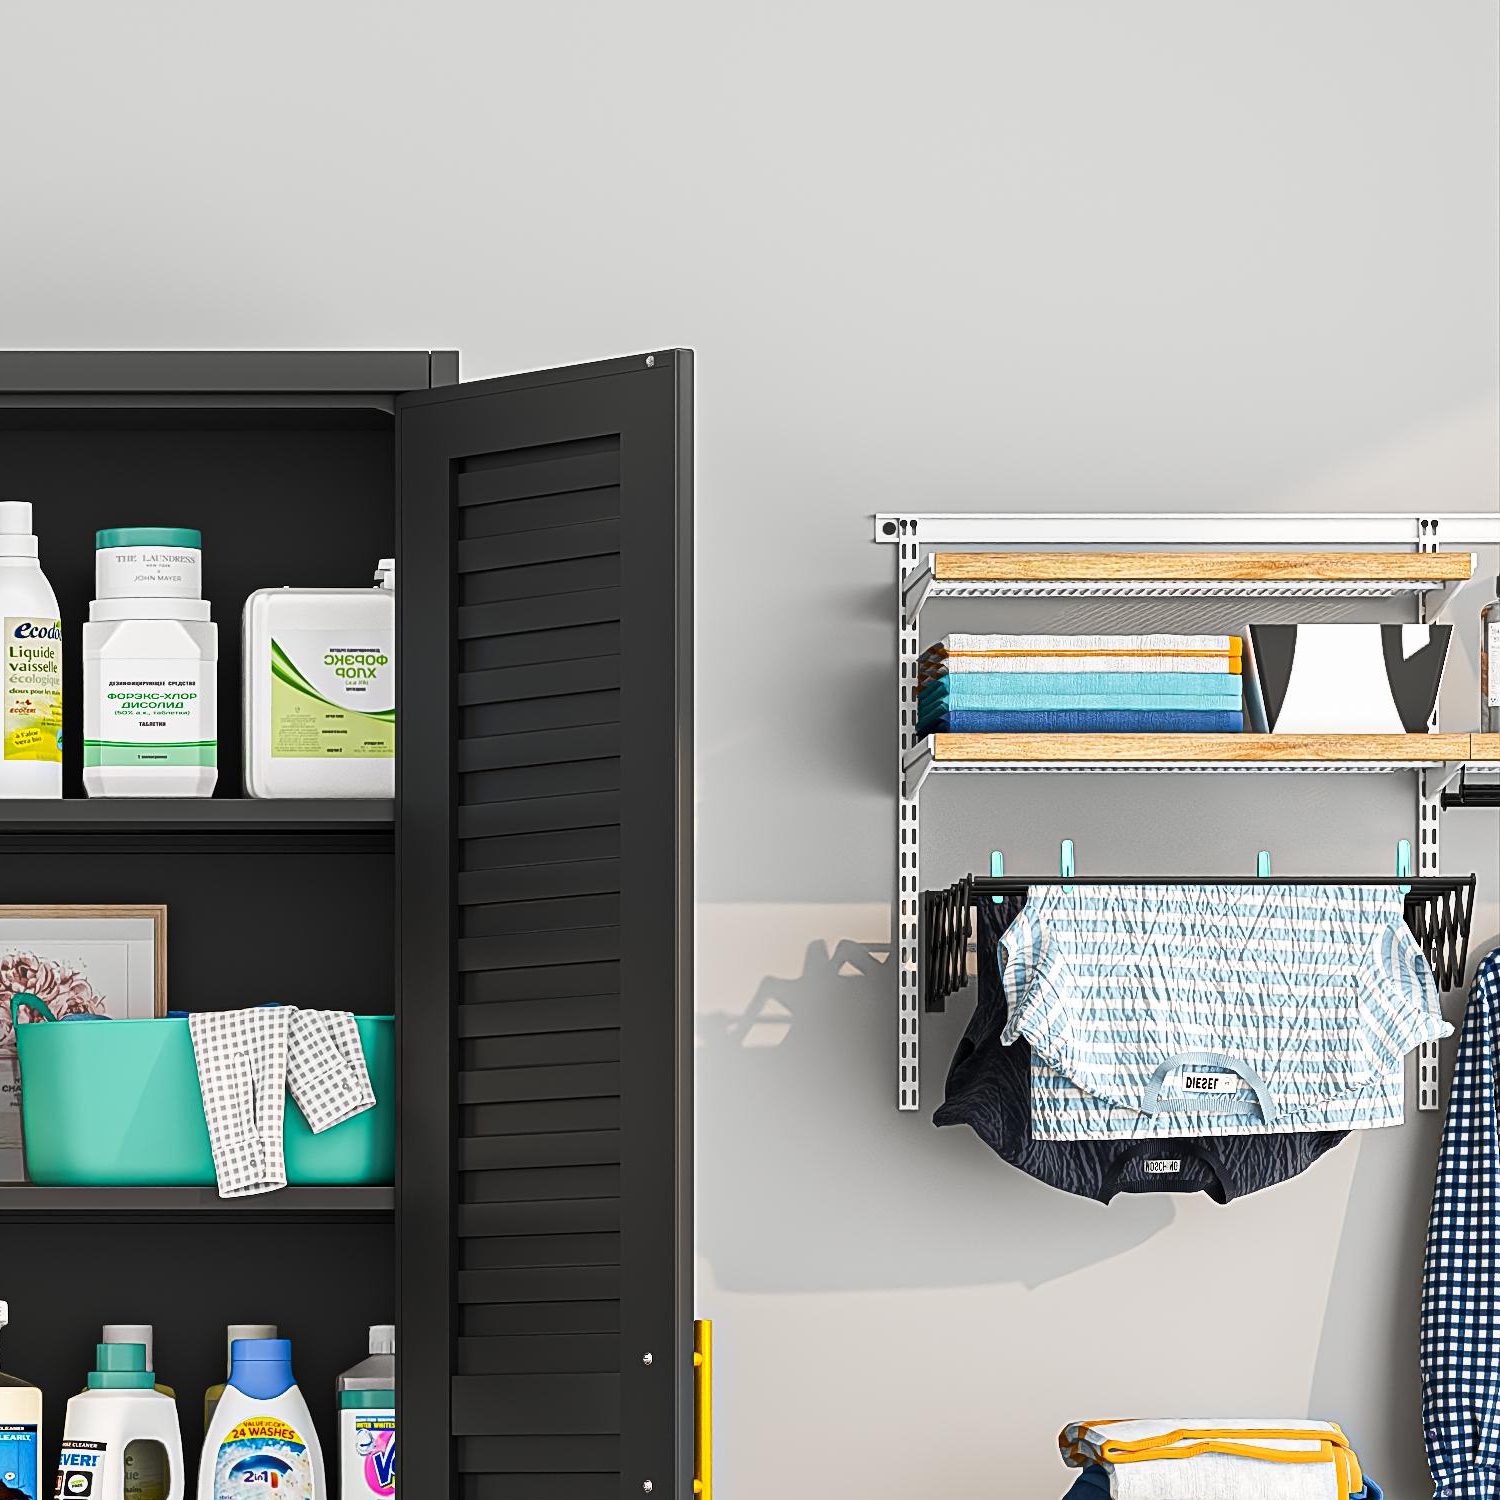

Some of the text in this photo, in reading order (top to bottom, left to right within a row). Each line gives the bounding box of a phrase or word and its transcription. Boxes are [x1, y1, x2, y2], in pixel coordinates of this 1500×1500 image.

[143, 555, 196, 563] LAUNDRESS
[9, 645, 55, 660] Liquide
[9, 661, 58, 673] vaisselle
[233, 1427, 296, 1439] 24 WASHES
